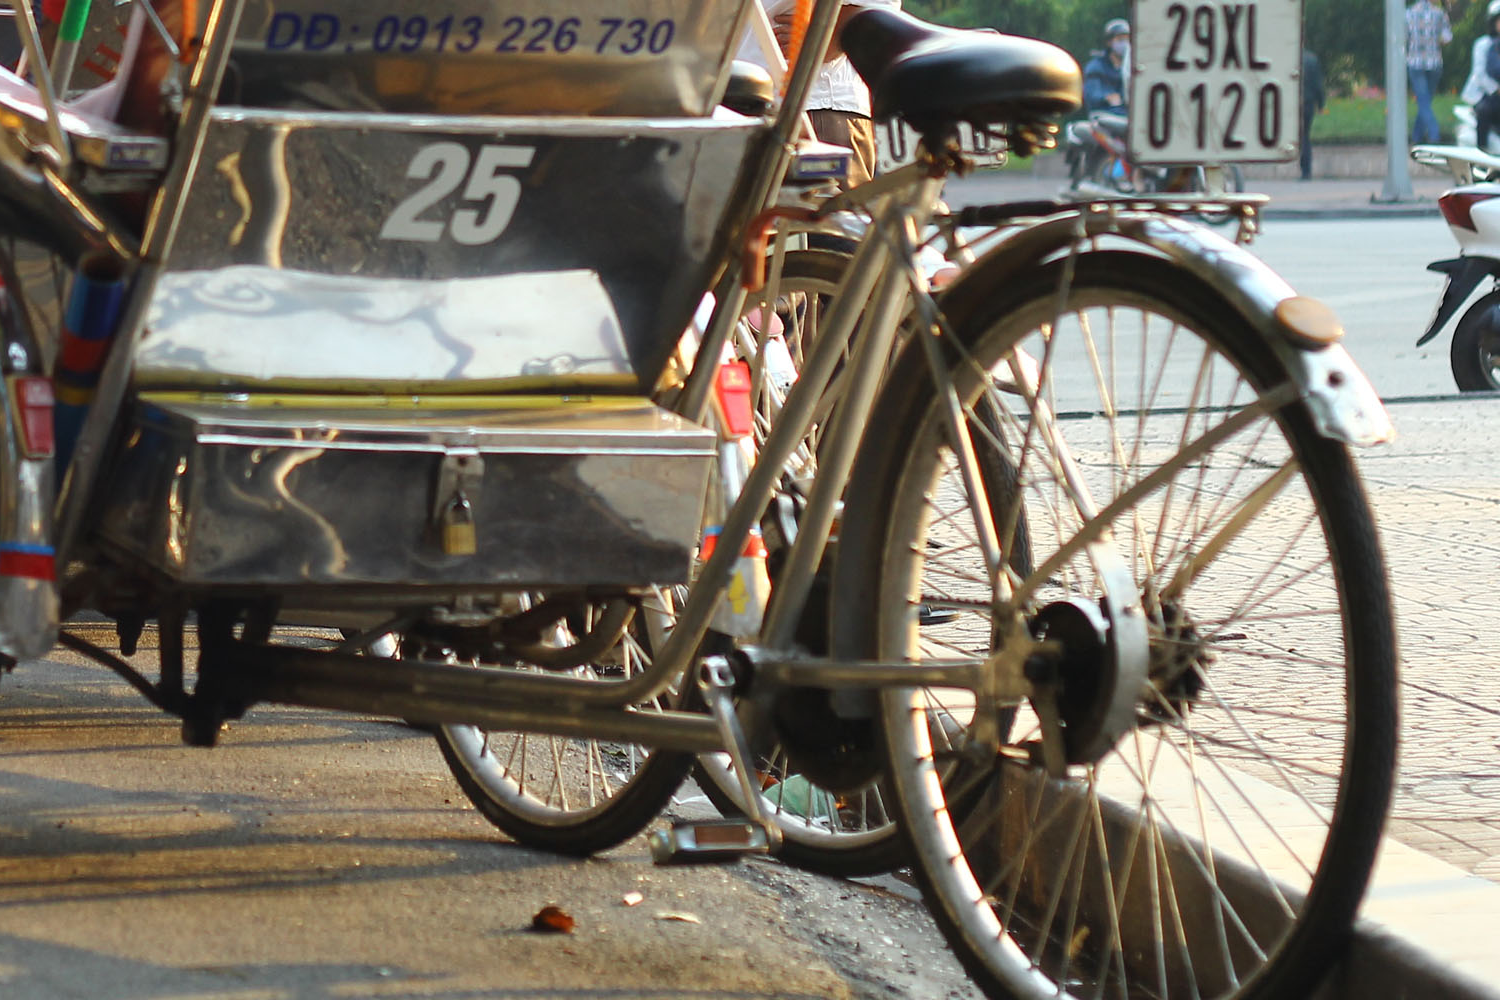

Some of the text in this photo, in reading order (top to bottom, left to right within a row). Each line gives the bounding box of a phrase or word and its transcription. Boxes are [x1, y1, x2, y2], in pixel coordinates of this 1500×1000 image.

[371, 14, 485, 55] 0913
[495, 16, 581, 55] 226
[595, 17, 676, 56] 730
[1165, 3, 1270, 71] 29XL
[1147, 82, 1282, 149] 0120
[379, 141, 536, 246] 25
